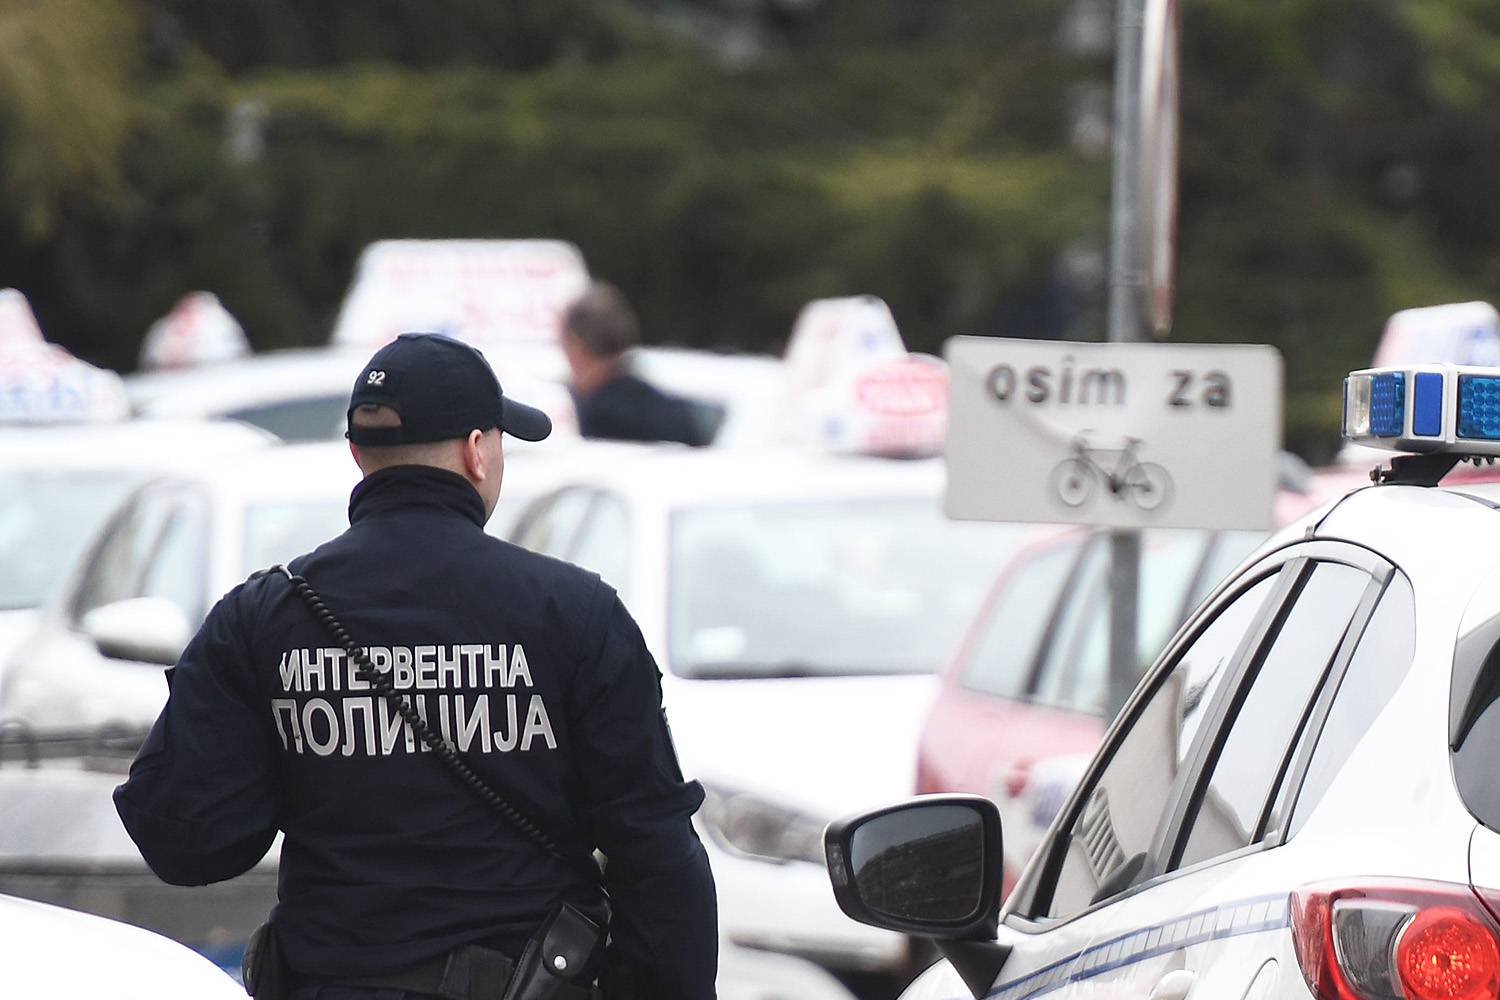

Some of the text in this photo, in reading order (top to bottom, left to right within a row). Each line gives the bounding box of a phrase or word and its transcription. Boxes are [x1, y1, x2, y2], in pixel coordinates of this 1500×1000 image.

[367, 370, 386, 385] 92
[985, 355, 1233, 407] osim za
[279, 644, 534, 692] ИНТЕРВЕНТНА
[271, 694, 557, 757] ПОЛИЦИЈА
